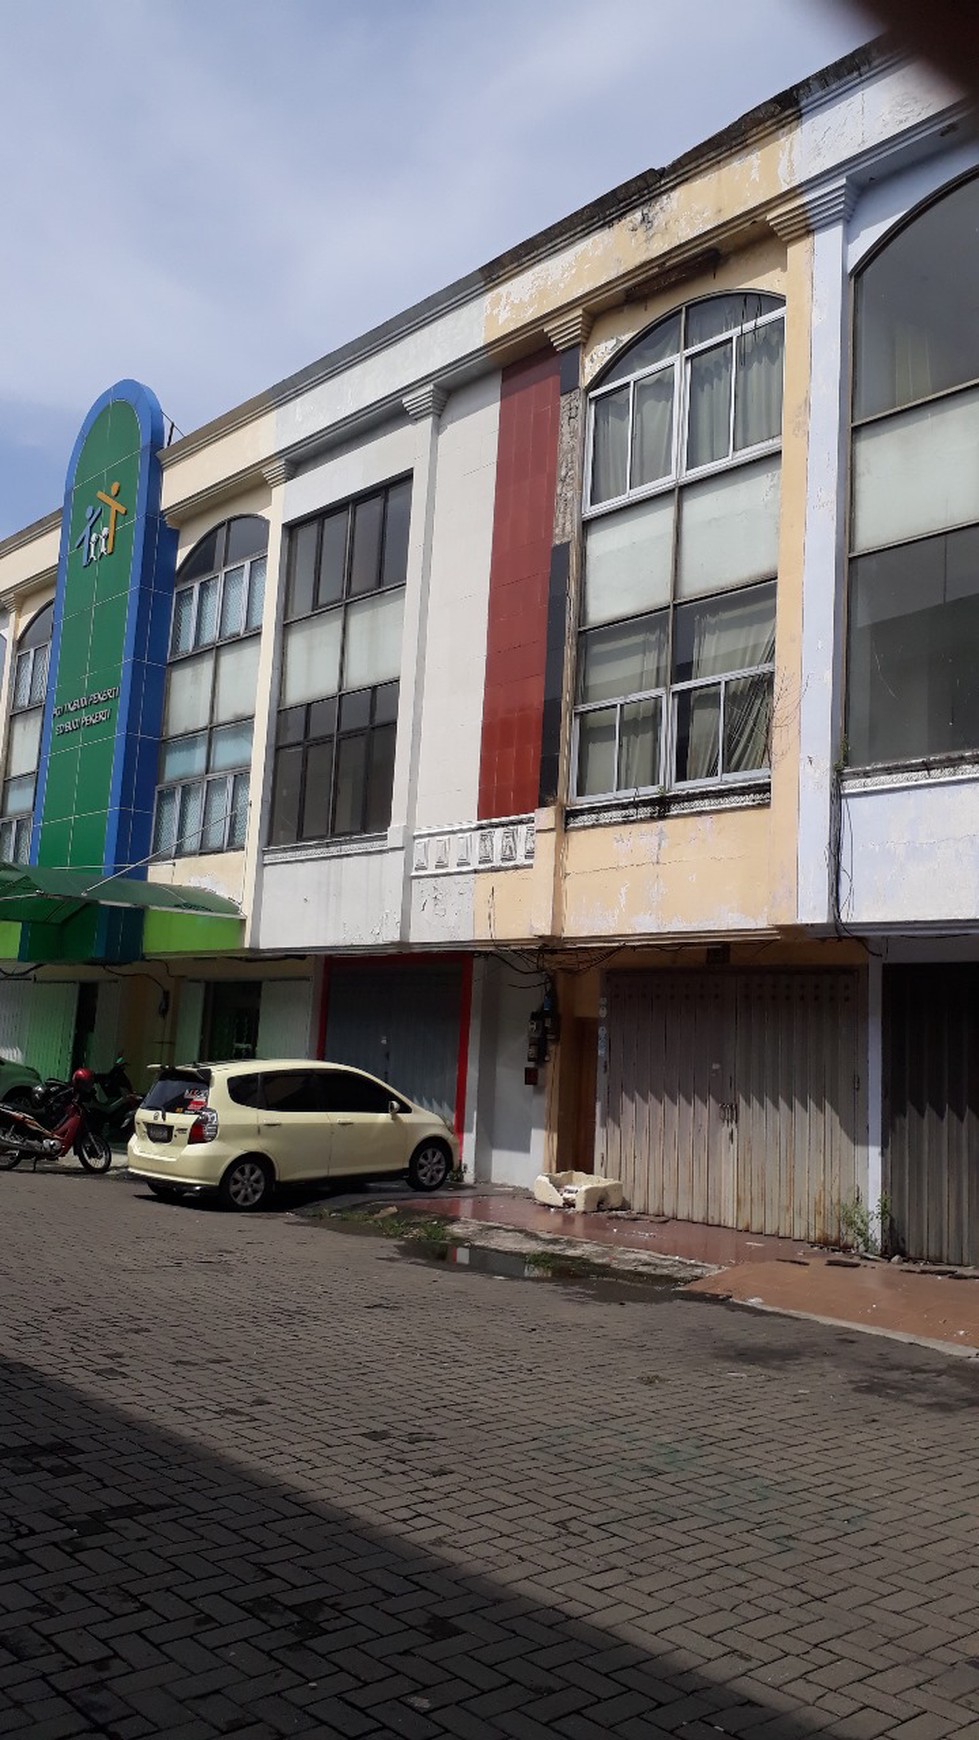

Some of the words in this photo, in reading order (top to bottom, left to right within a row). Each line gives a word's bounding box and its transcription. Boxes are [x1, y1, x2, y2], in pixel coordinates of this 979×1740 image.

[88, 686, 119, 705] PEKERTI
[65, 718, 80, 732] BUDI
[81, 709, 111, 726] PEKERTI
